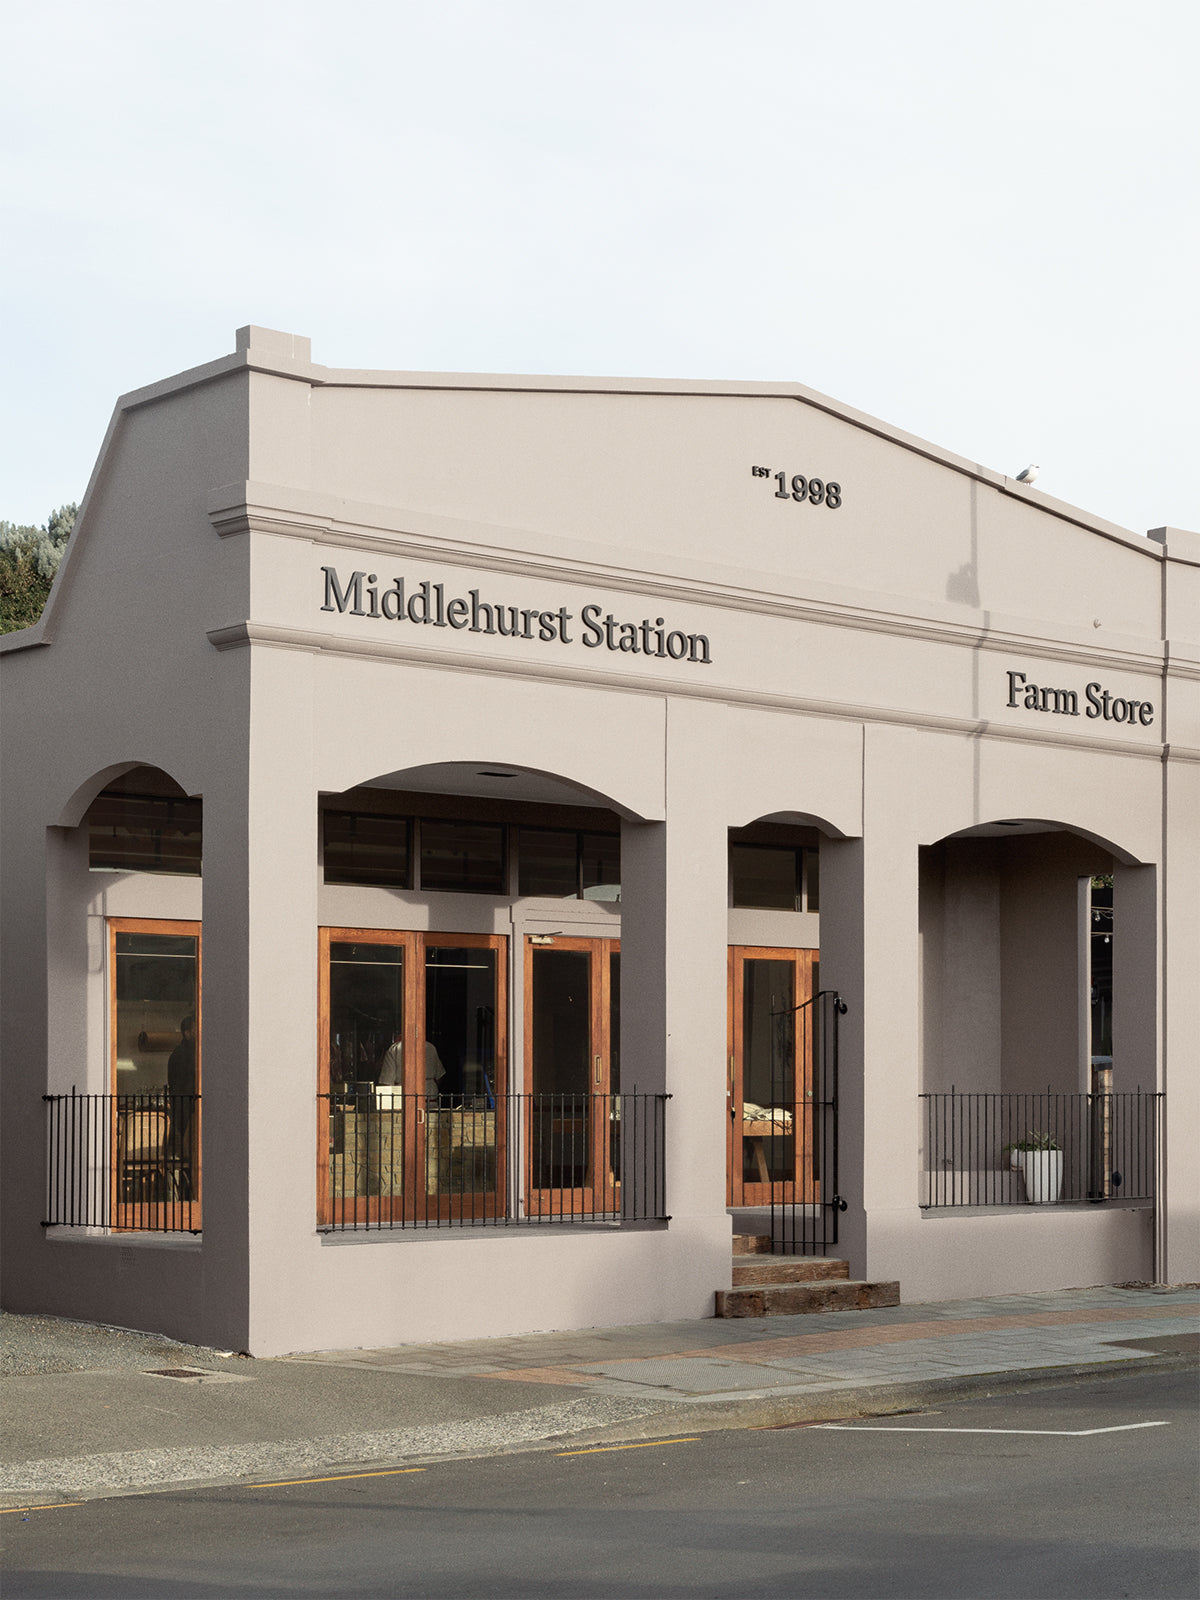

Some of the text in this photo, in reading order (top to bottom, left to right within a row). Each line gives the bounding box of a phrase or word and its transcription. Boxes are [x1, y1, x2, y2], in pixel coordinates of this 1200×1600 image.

[752, 465, 843, 510] EST 1998
[320, 567, 712, 665] Middlehurst Station
[1006, 671, 1153, 727] Farm Store
